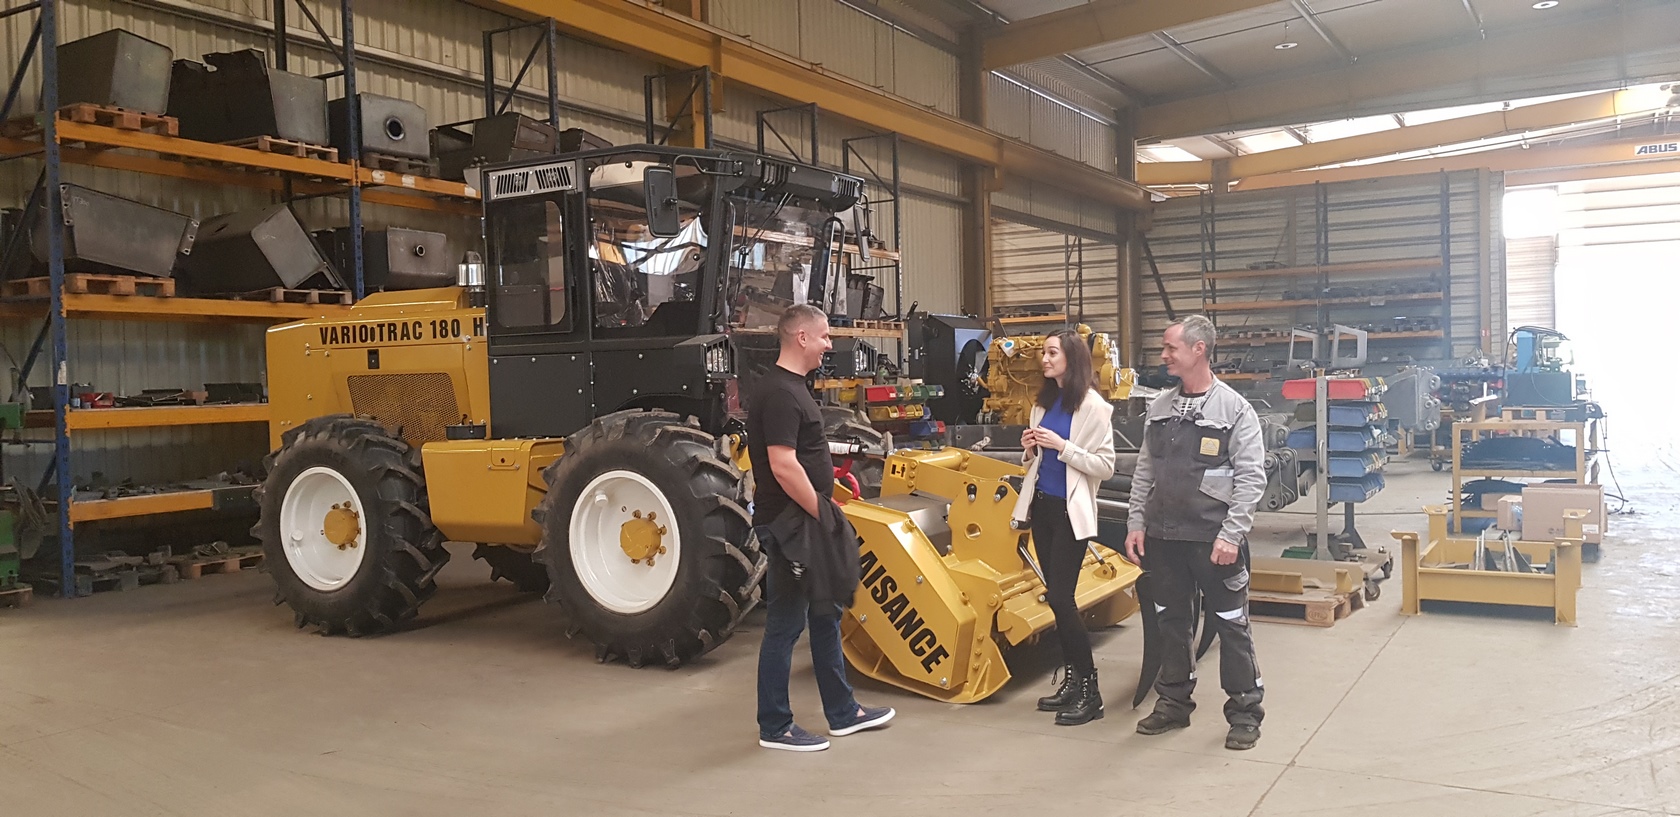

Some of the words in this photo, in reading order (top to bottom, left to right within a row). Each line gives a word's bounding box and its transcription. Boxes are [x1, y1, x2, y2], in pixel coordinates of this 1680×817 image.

[1637, 143, 1677, 154] ABUS
[429, 319, 461, 338] 180
[473, 317, 484, 337] H
[848, 521, 949, 674] AISANCE
